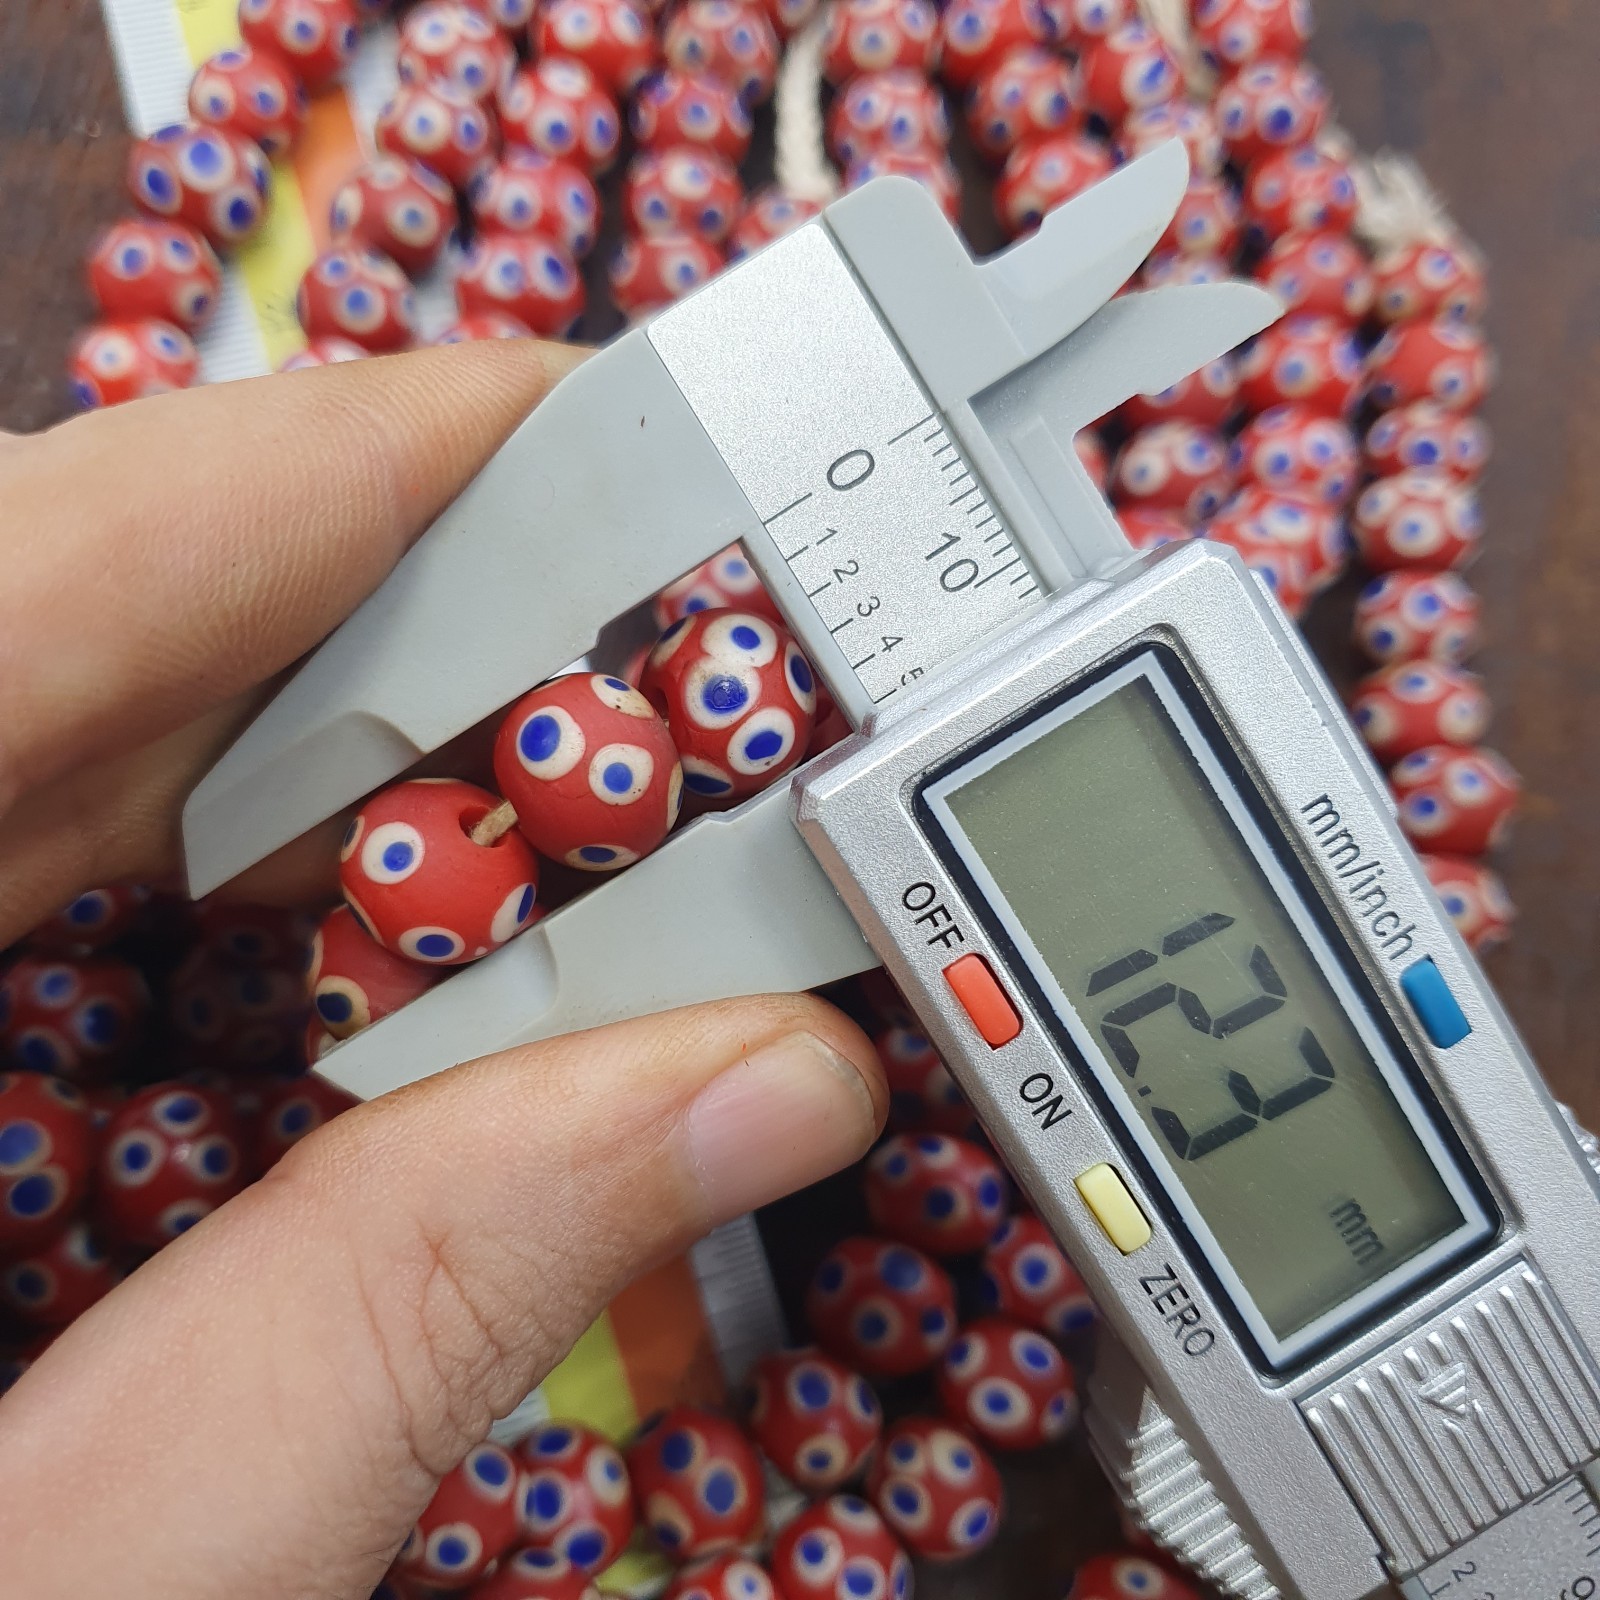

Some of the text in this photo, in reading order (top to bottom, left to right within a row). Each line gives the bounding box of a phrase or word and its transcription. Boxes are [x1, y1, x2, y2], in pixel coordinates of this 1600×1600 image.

[826, 449, 875, 491] 0
[816, 527, 838, 546] 1
[925, 532, 979, 592] 10
[832, 559, 859, 584] 2
[856, 595, 881, 617] 3
[880, 635, 904, 653] 4
[1300, 793, 1416, 961] mm/inch
[902, 881, 965, 948] OFF
[1086, 912, 1335, 1161] 12.3
[1019, 1072, 1073, 1131] ON
[1329, 1198, 1384, 1266] mm
[1138, 1262, 1216, 1358] ZERO
[1452, 1561, 1477, 1582] 2
